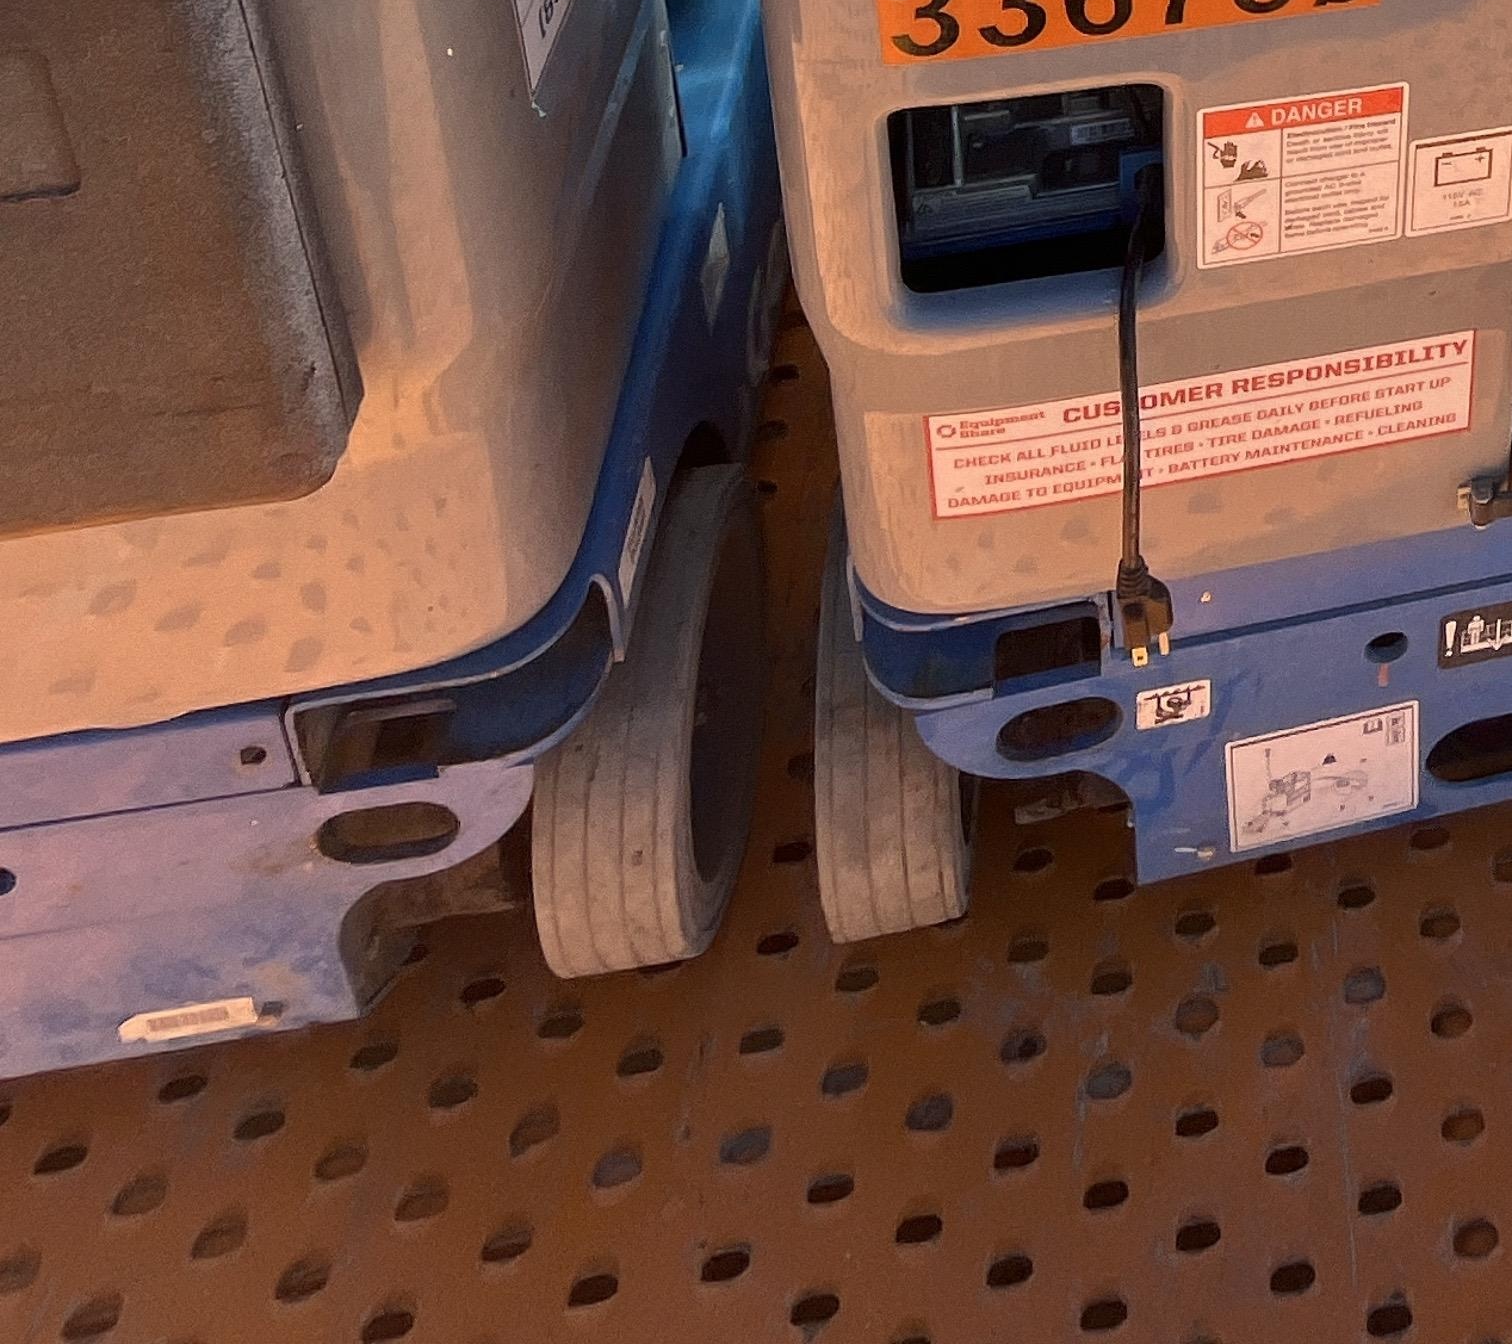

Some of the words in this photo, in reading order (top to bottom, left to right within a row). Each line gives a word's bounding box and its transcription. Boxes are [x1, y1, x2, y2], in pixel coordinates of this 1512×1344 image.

[1271, 98, 1363, 125] DANGER
[954, 454, 1011, 469] CHECK
[1017, 449, 1045, 462] ALL
[1051, 440, 1101, 456] FLUID
[1107, 426, 1166, 446] LEELS
[1188, 412, 1252, 433] GREASE
[1256, 402, 1304, 420] DAILY
[1309, 391, 1371, 411] BEFORE
[1375, 381, 1425, 400] START
[1430, 377, 1452, 390] UP
[960, 412, 1046, 429] Equipment
[1063, 383, 1223, 423] CUSOMER
[1232, 340, 1468, 394] RESPONSIBILITY
[948, 491, 1021, 508] DAMAGE
[1028, 488, 1048, 497] TO
[1168, 452, 1240, 474] BATTERY
[1245, 431, 1363, 460] MAINTENANCE
[1377, 413, 1457, 437] CLEANING
[960, 427, 1005, 438] Share
[985, 462, 1086, 485] INSURANCE
[1145, 443, 1195, 459] TIRES
[1207, 434, 1247, 448] TIRE
[1251, 418, 1321, 440] DAMAGE
[1335, 401, 1423, 426] REFUELING
